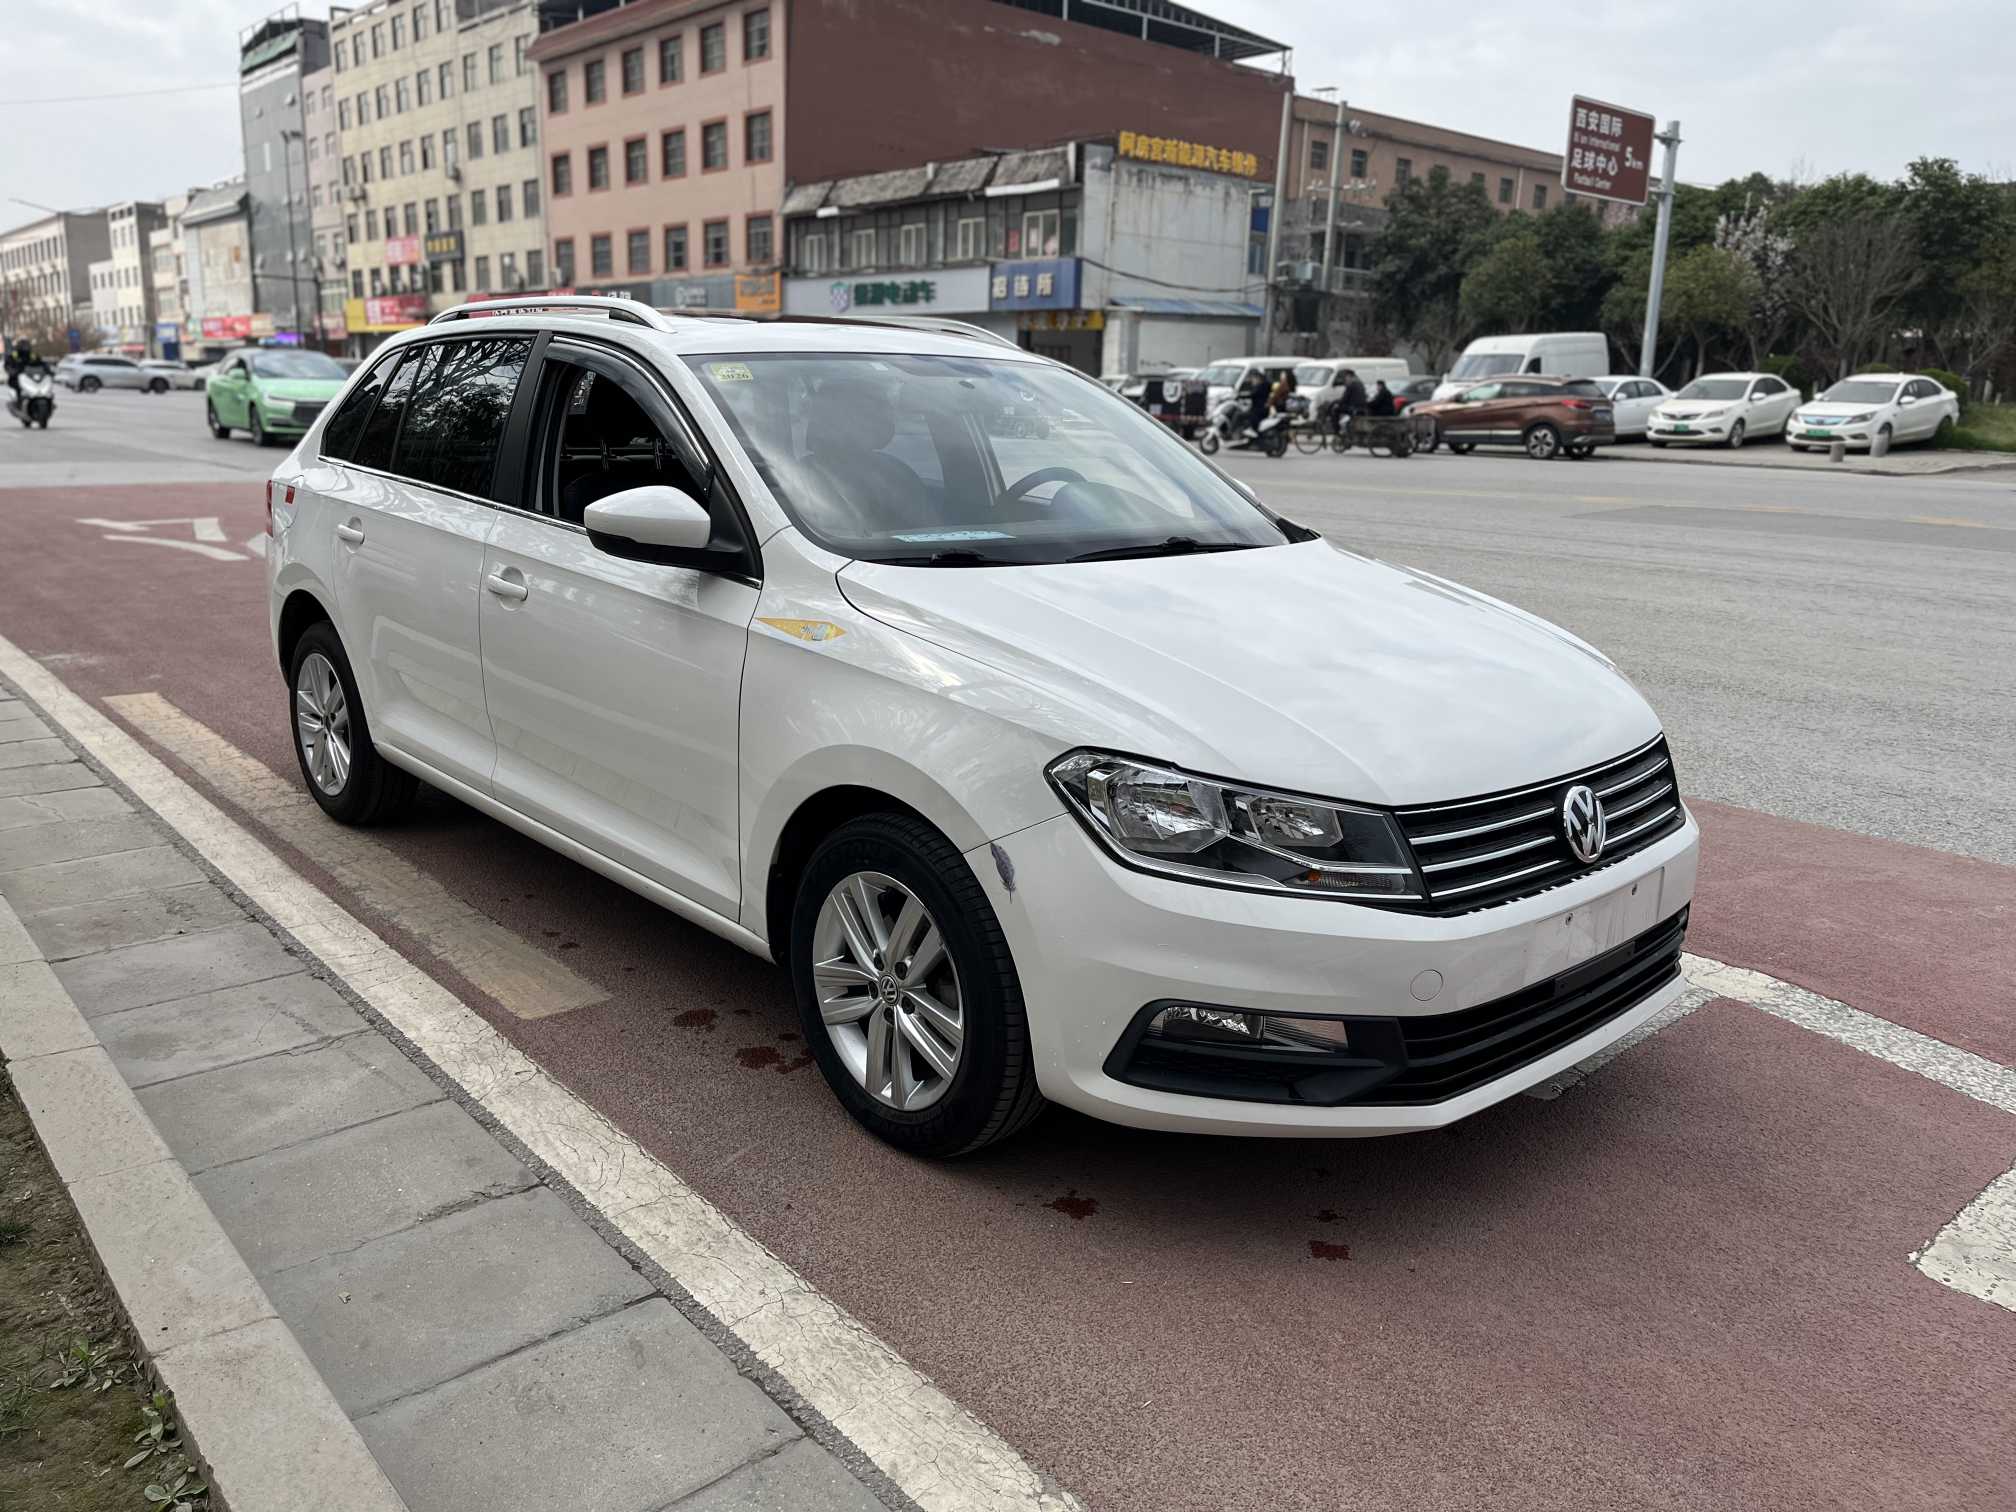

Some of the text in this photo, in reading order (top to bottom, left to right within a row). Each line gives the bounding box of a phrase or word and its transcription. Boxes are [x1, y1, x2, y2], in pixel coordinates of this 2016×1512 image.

[1576, 108, 1622, 136] 西安国际
[1571, 148, 1618, 176] 足球中心
[991, 271, 1054, 299] 招待所
